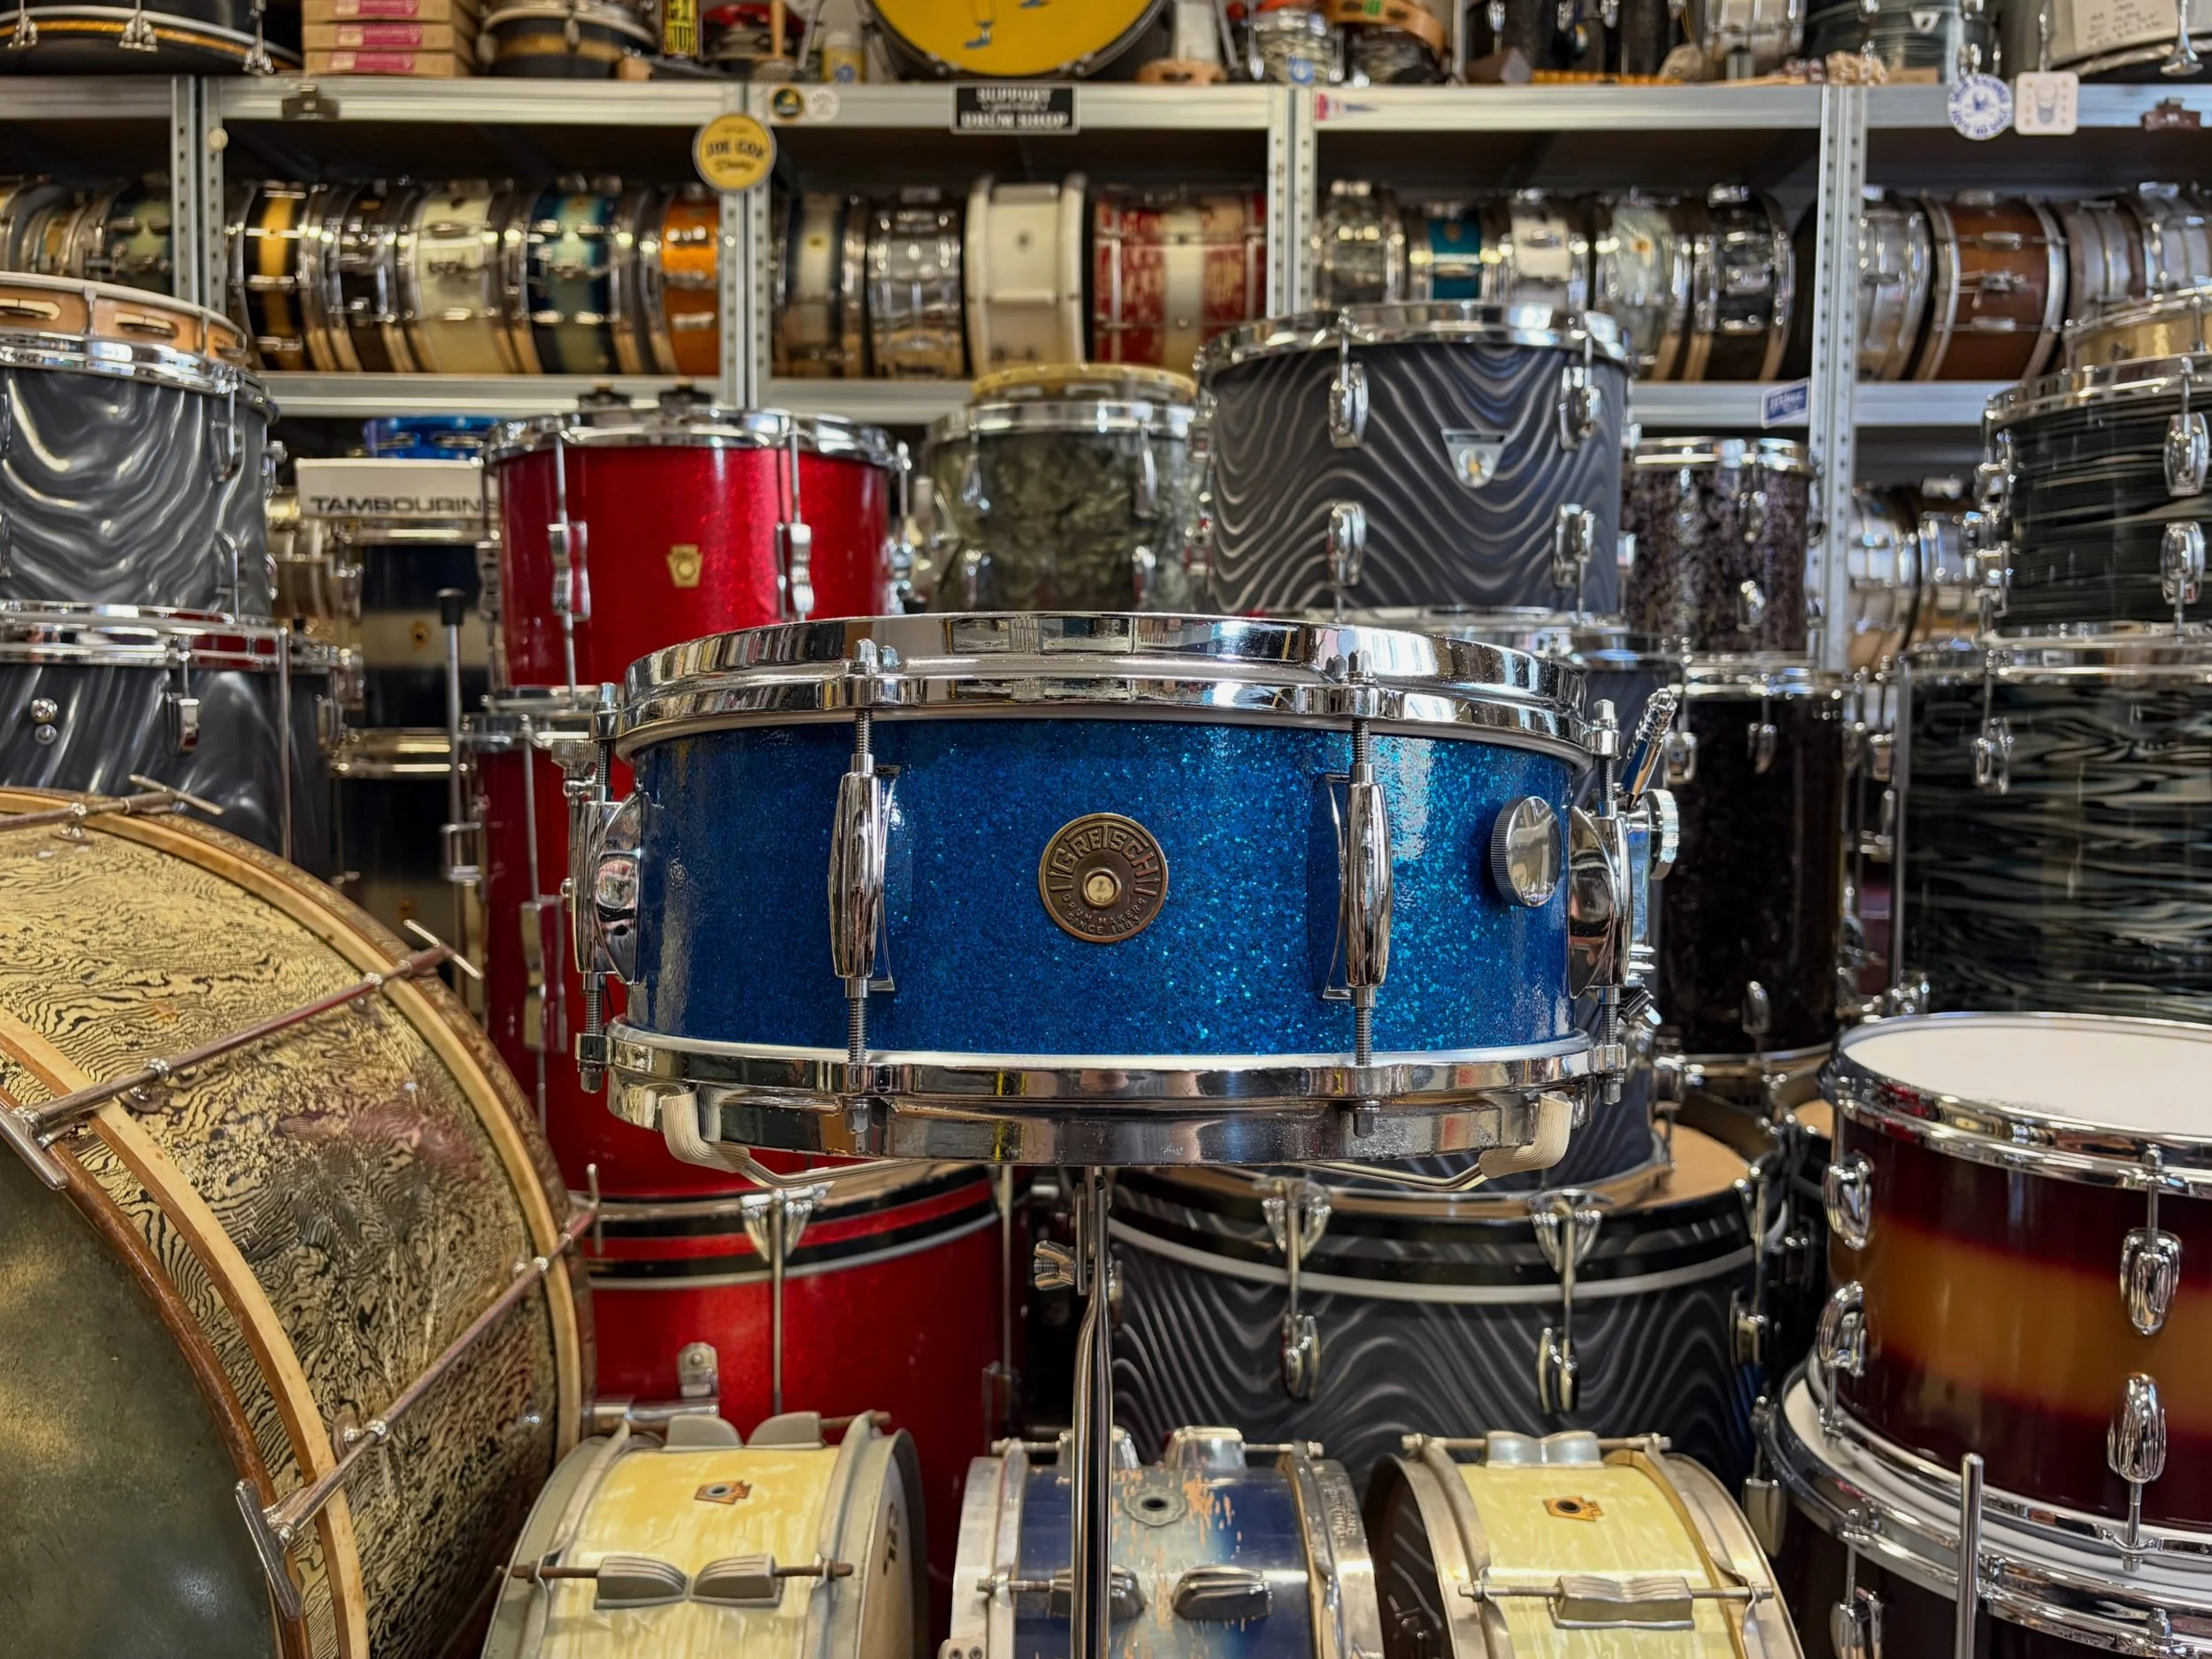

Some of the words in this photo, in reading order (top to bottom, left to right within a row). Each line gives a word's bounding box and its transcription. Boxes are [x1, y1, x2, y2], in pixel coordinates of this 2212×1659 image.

[976, 87, 1051, 102] SUPPORT
[960, 111, 1015, 128] DRUM
[1018, 111, 1069, 128] SHOP
[1050, 822, 1158, 878] GRETSCH
[1063, 894, 1092, 922] DRUM
[1098, 897, 1146, 926] MAKERS
[1065, 912, 1103, 934] SINCE
[1111, 916, 1140, 934] 1883
